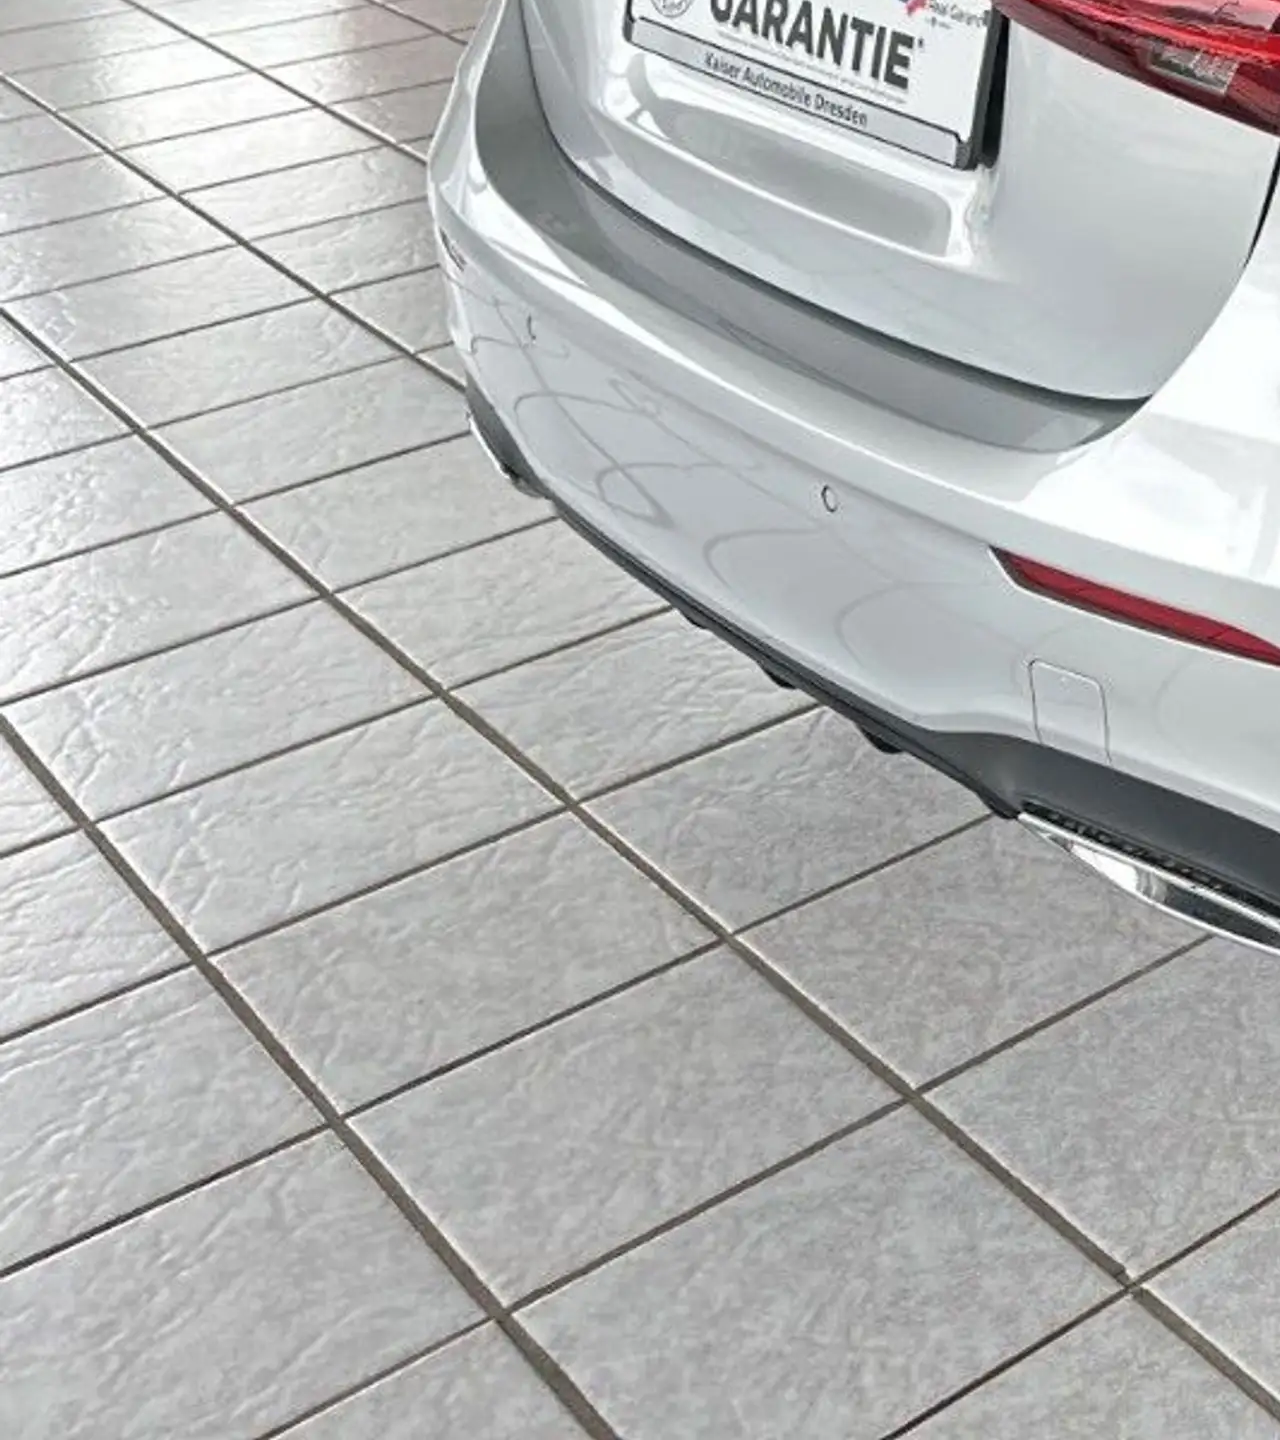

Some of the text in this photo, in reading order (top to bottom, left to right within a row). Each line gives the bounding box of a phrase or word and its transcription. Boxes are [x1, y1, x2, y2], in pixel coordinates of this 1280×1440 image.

[705, 52, 741, 78] Kaiser
[742, 67, 812, 106] Automobile
[814, 93, 868, 128] Dresden
